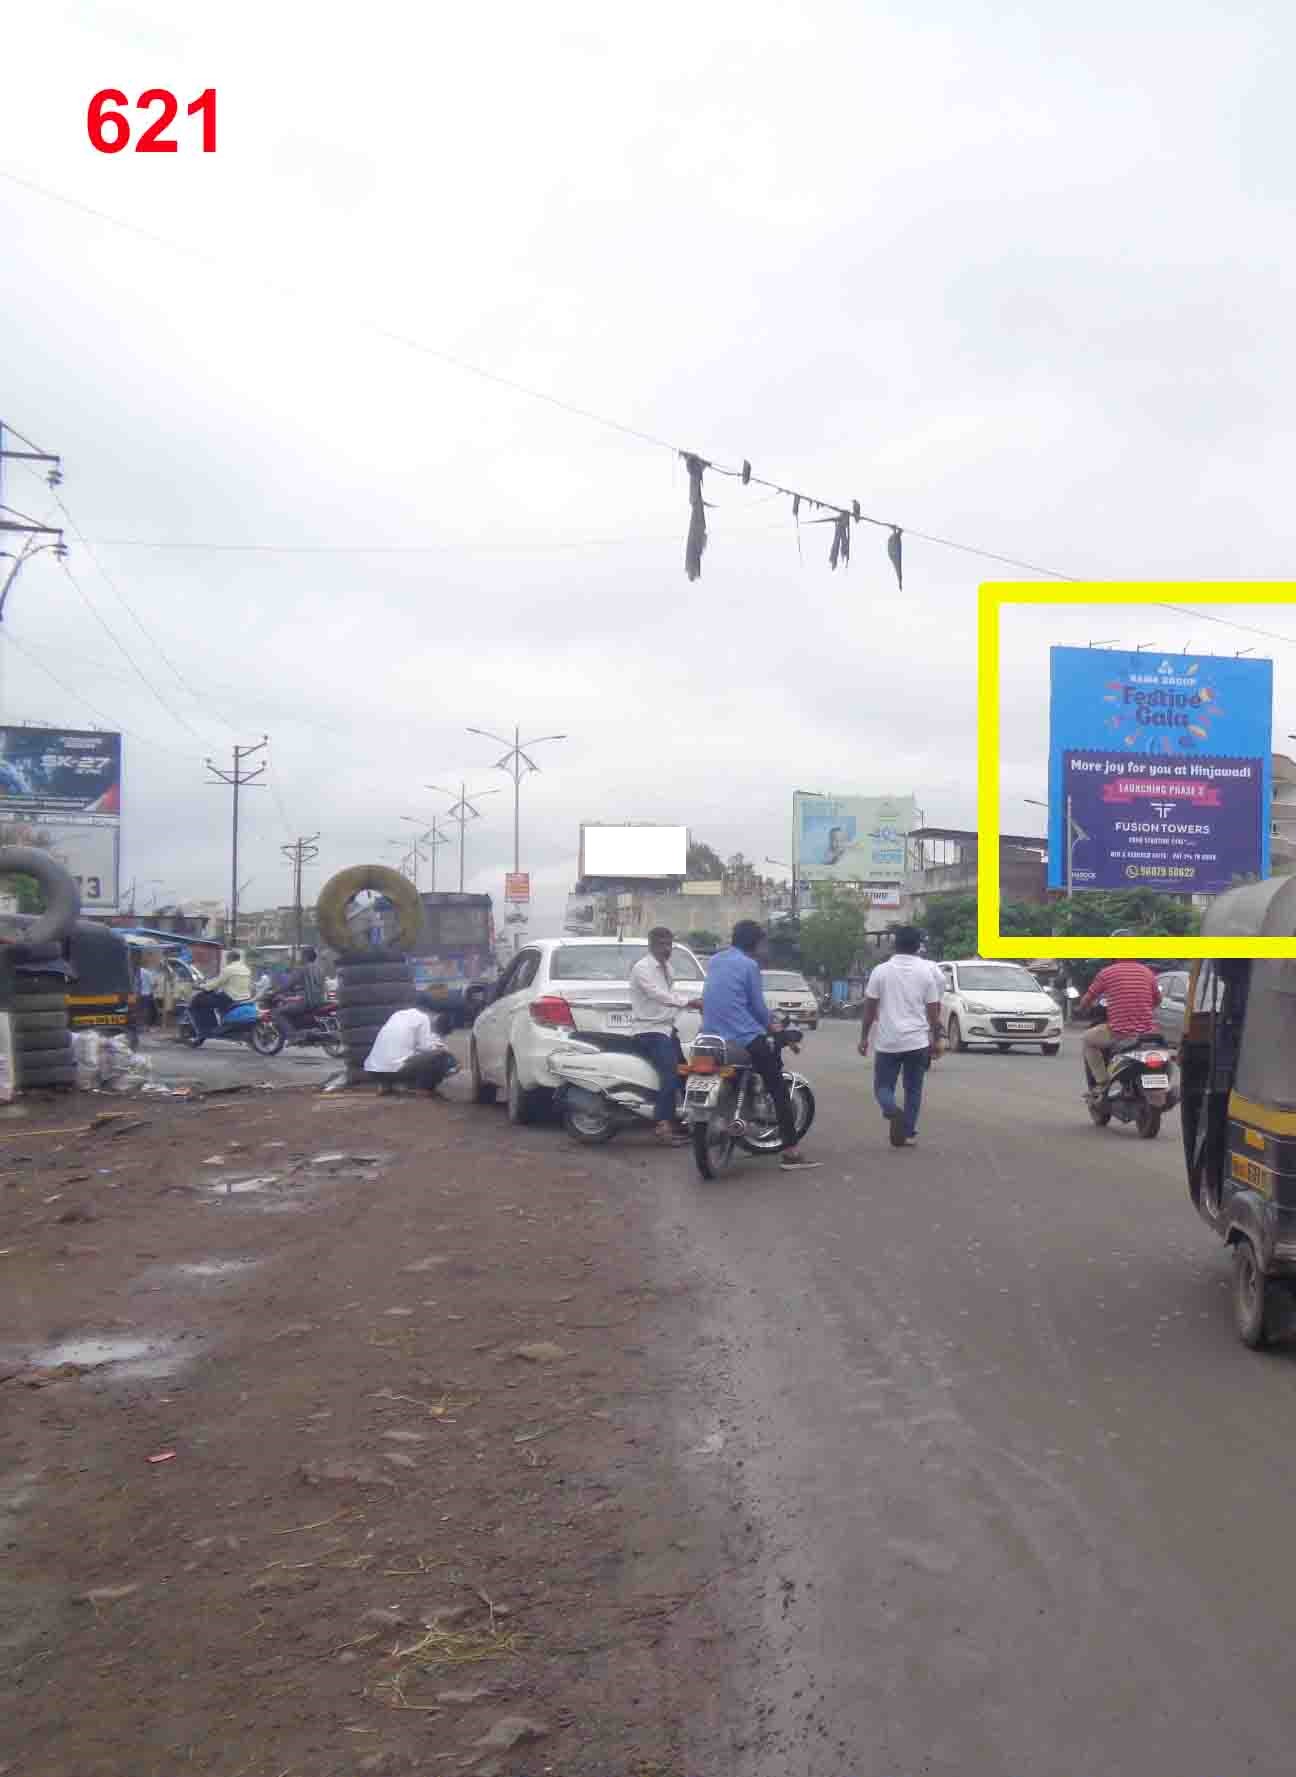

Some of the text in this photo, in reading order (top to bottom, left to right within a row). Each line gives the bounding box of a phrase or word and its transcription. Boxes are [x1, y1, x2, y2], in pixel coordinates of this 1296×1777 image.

[1122, 685, 1202, 709] Festive
[1136, 706, 1190, 728] Gala
[1071, 759, 1252, 779] More joy for you at Hinjawadi
[1118, 783, 1168, 795] LAUNCHING
[1169, 785, 1195, 796] PHASE
[1114, 822, 1210, 835] FUSION TOWERS
